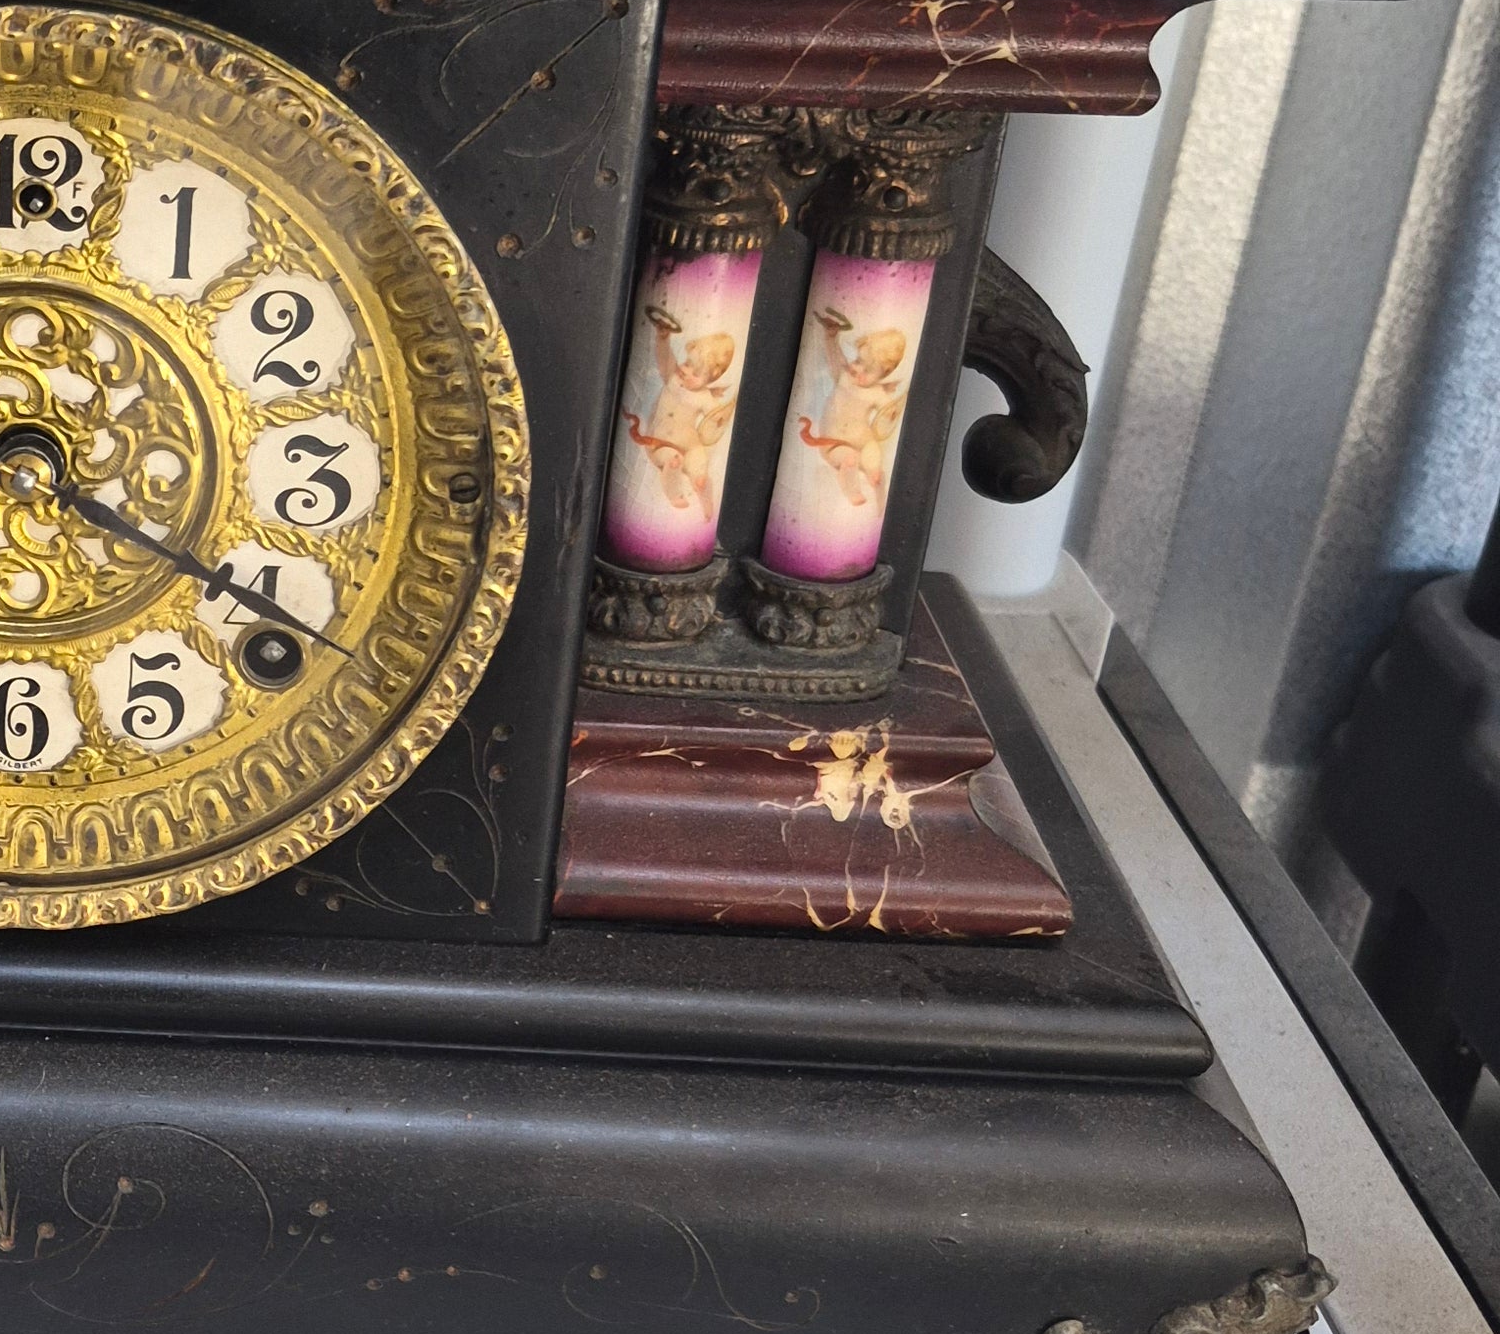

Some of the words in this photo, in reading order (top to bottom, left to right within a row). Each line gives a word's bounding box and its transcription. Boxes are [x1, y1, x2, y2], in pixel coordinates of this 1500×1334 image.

[159, 186, 198, 280] 1
[251, 289, 322, 388] 2
[273, 435, 353, 528] 3
[120, 651, 184, 741] 5
